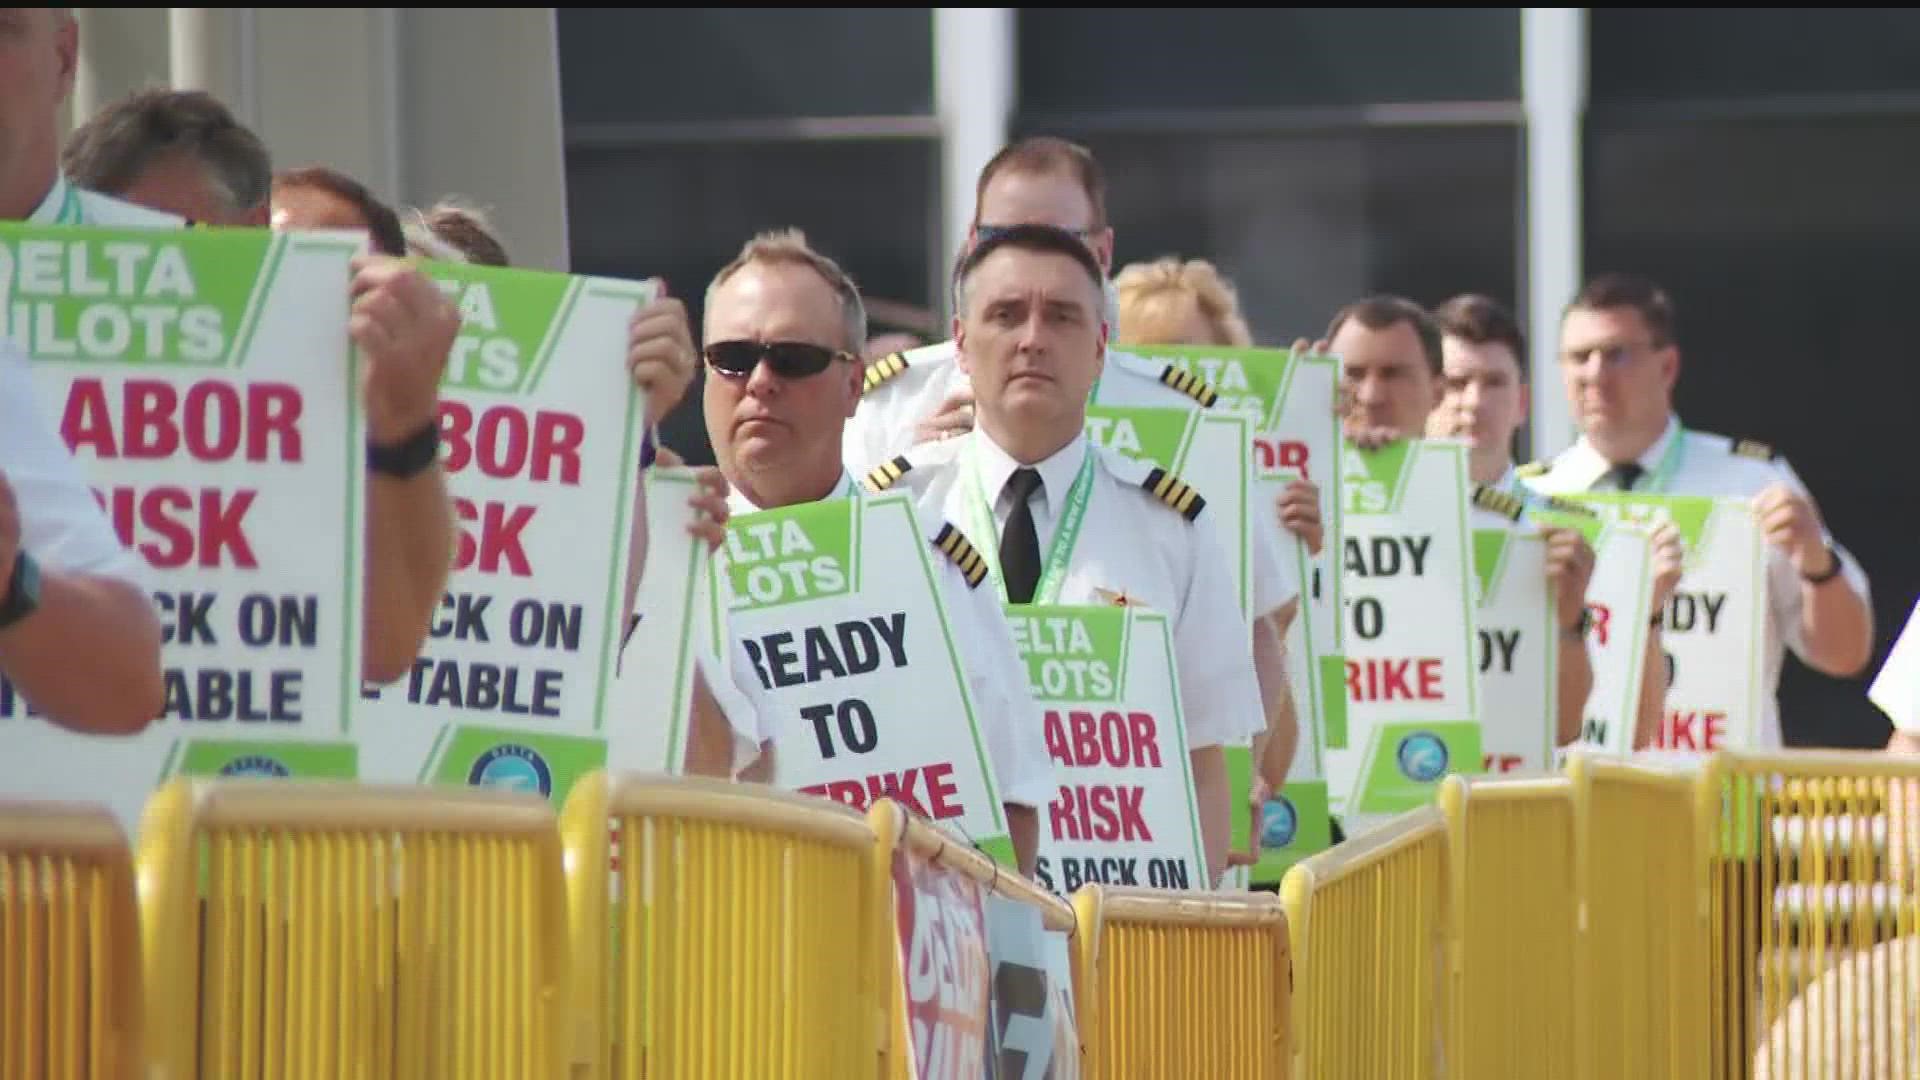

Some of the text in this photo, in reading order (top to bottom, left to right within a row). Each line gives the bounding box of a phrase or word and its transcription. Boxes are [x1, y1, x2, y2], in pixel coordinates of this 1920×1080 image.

[0, 240, 196, 297] ELTA
[60, 377, 304, 464] ABOR
[1344, 536, 1430, 577] ADY
[238, 593, 318, 648] ON
[509, 598, 583, 652] ON
[1344, 597, 1384, 641] O
[161, 668, 304, 723] ABLE
[408, 656, 564, 718] TABLE
[801, 698, 878, 760] TO
[1044, 710, 1162, 768] ABOR
[794, 761, 965, 821] RIKE
[1048, 785, 1153, 842] RISK
[1062, 857, 1138, 893] BACK
[1147, 858, 1190, 890] ON
